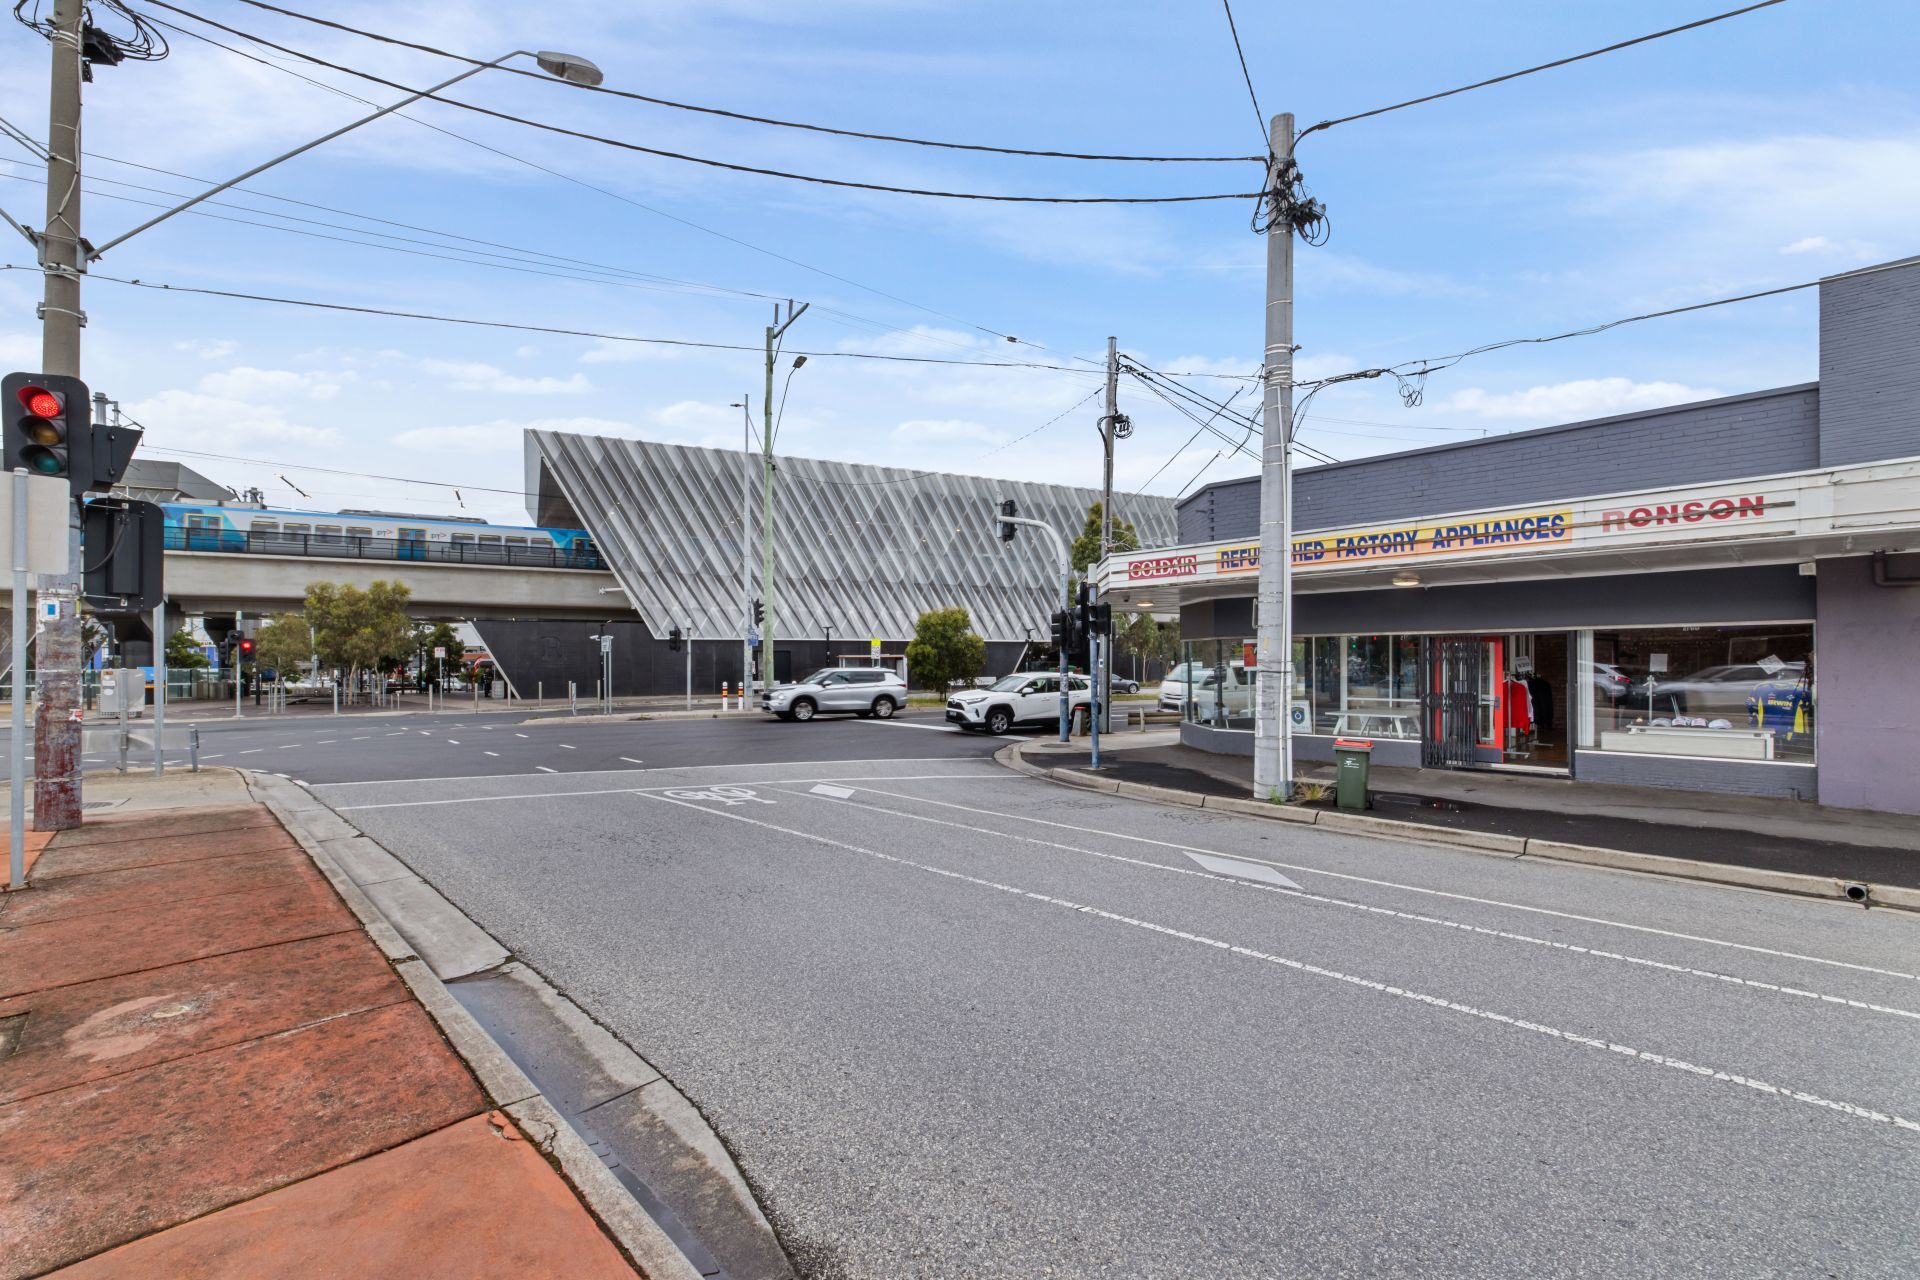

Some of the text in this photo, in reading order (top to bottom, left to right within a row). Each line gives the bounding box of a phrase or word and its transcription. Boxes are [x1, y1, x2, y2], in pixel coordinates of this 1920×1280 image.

[1602, 495, 1764, 533] RONSON
[1337, 530, 1418, 558] FACTORY
[1432, 514, 1566, 549] APPLIANCES
[1130, 556, 1196, 578] GOLDAIR
